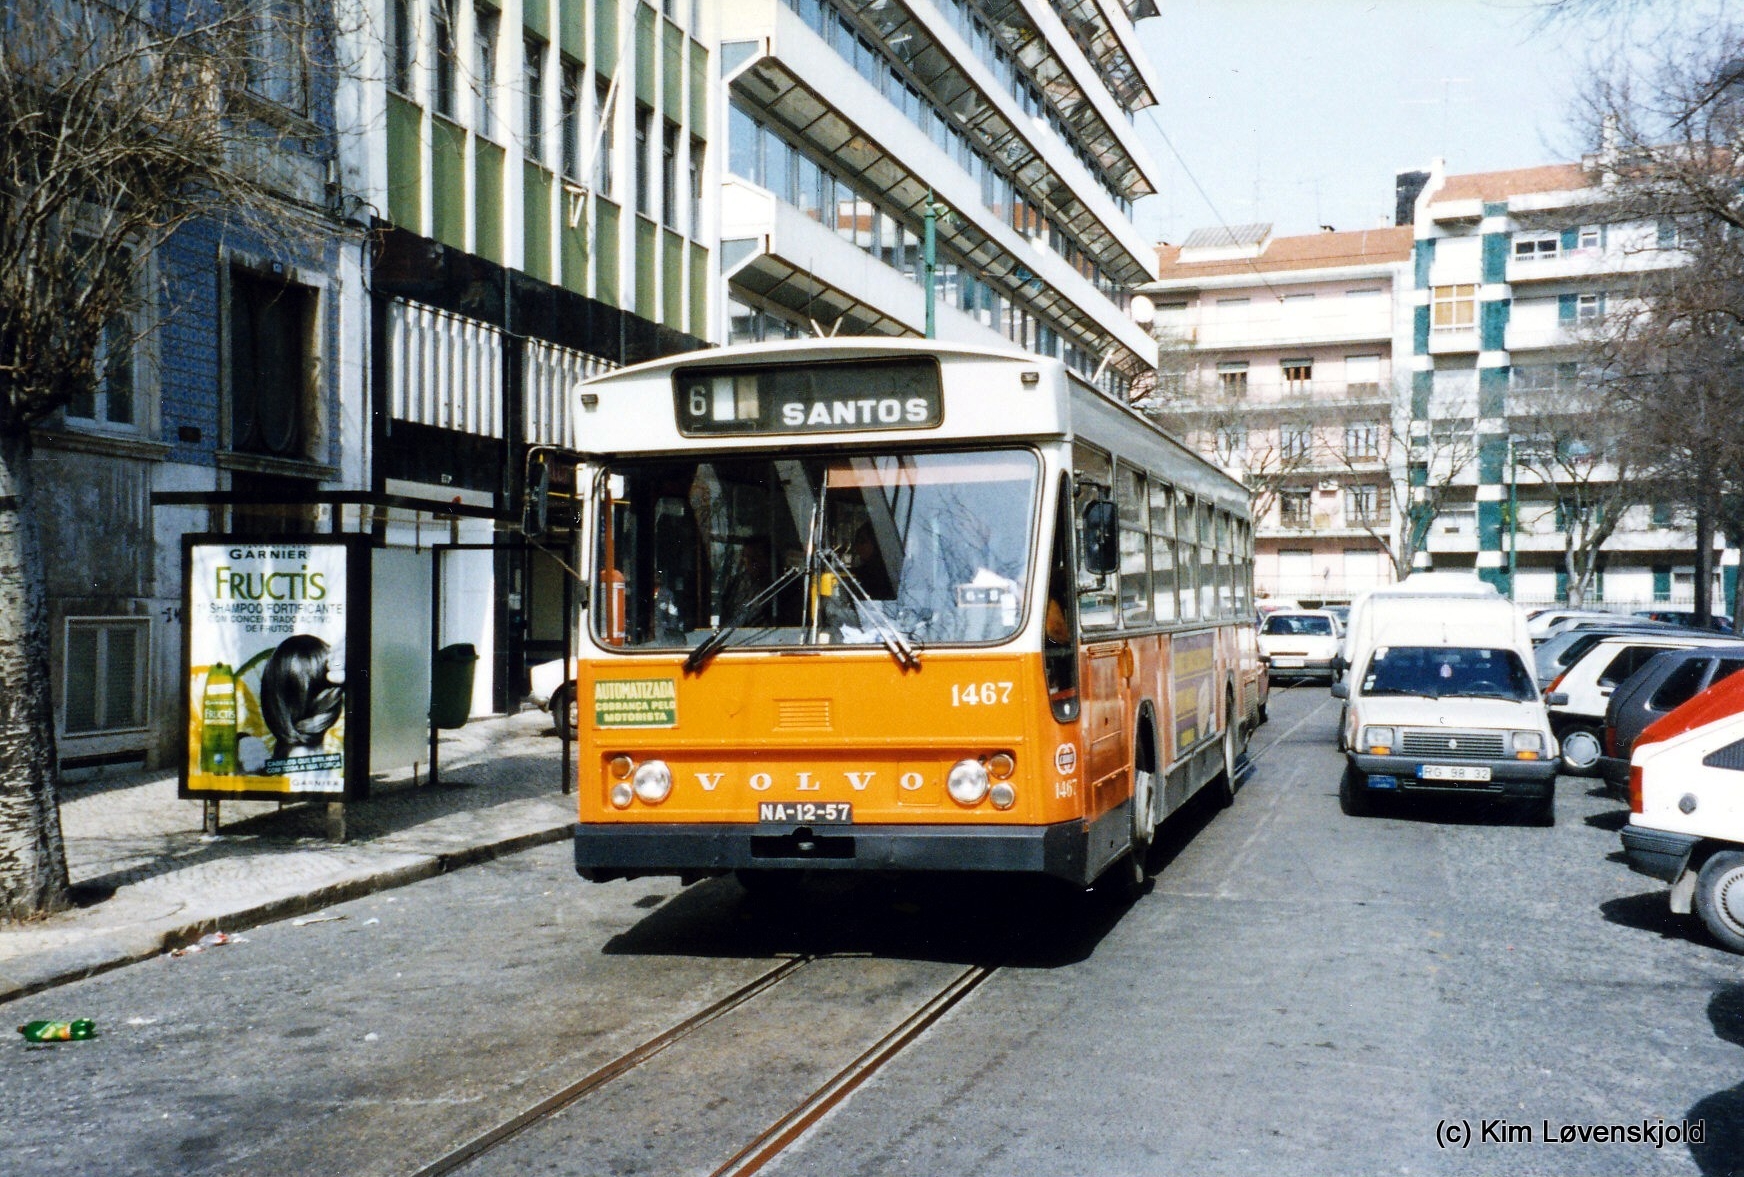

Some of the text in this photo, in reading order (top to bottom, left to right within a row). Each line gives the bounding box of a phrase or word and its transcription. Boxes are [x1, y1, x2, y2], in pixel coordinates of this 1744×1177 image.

[690, 385, 706, 416] 6
[782, 398, 928, 426] SANTOS
[229, 549, 307, 560] GARNIER
[210, 603, 263, 614] SHAMPOO
[266, 603, 343, 614] FORTIFICANTE
[245, 624, 258, 633] DE
[595, 681, 675, 700] AUTOMATIZADA
[951, 682, 1013, 707] 1467
[595, 700, 675, 711] COBRANÇA PELO
[603, 712, 668, 722] MOTORISTA
[694, 772, 924, 791] VOLVO
[1055, 779, 1078, 799] 1467
[760, 803, 850, 821] NA-12-57
